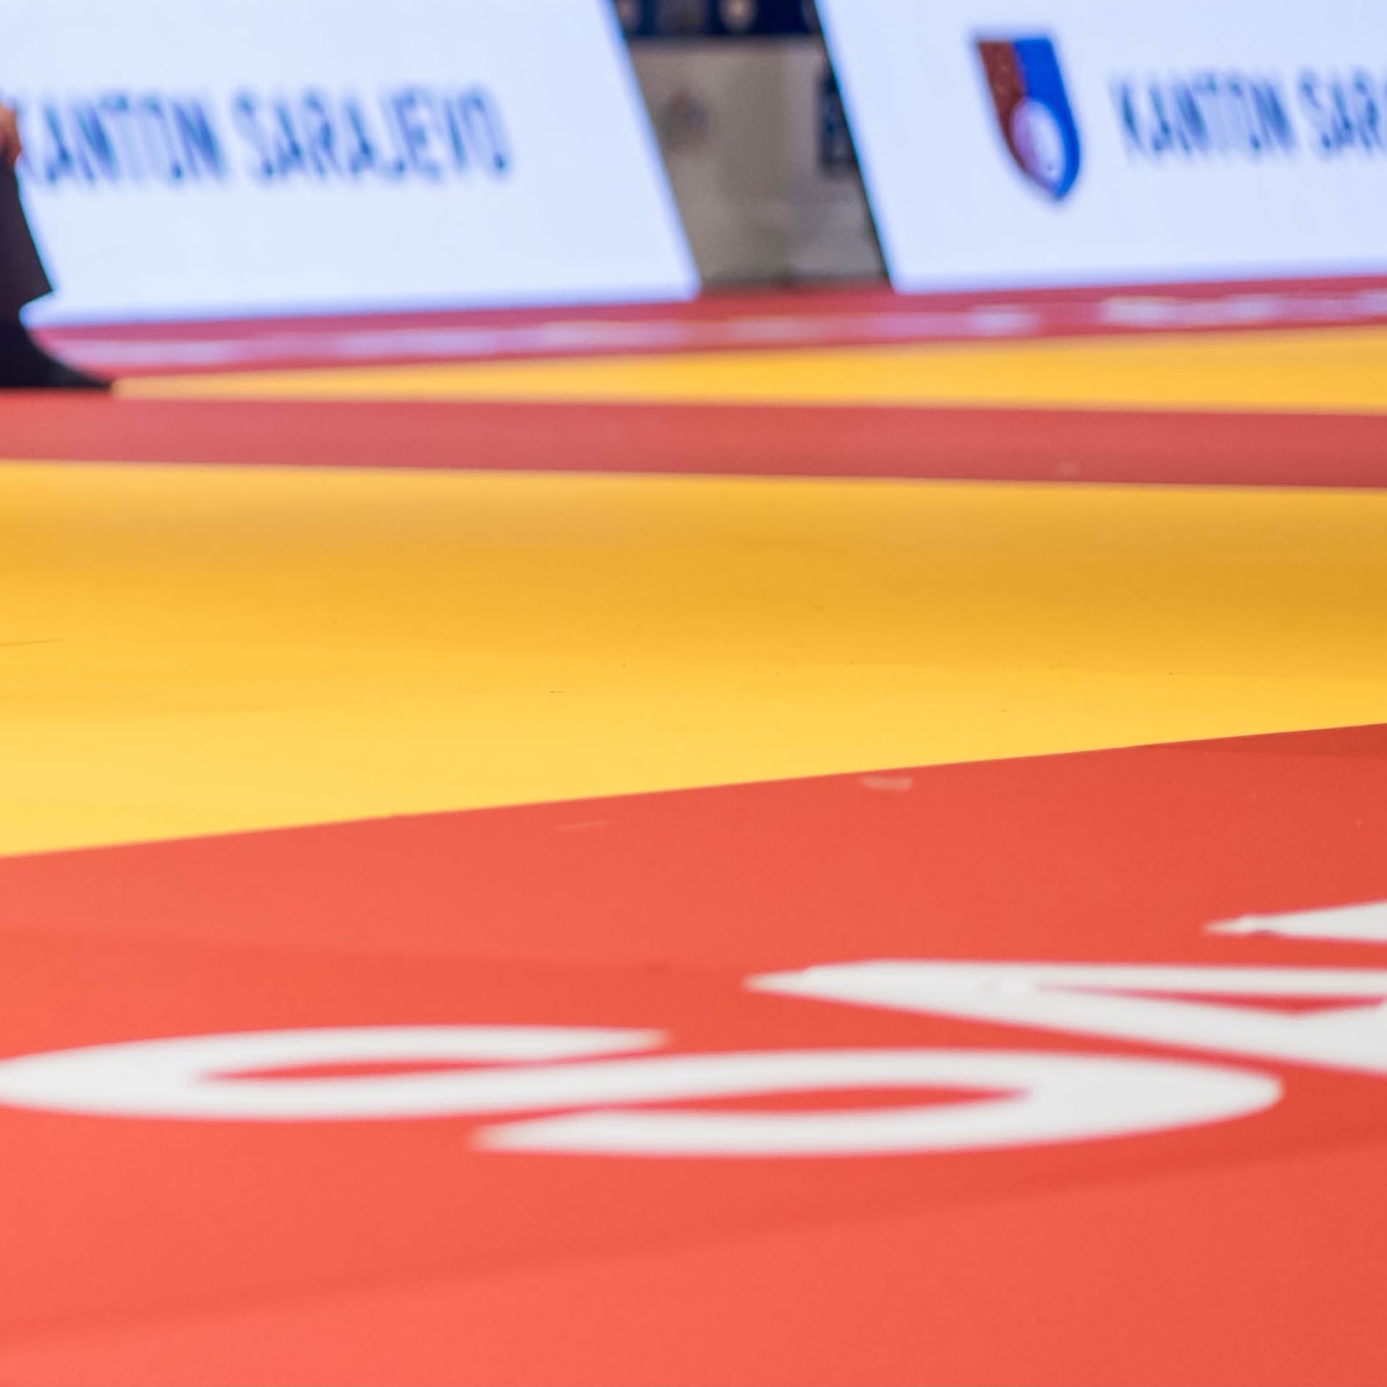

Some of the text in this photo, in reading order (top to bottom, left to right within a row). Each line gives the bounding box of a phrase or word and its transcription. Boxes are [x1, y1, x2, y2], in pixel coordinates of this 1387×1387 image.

[23, 88, 513, 185] ANTON SARAJEVO
[1110, 66, 1387, 160] KANTON SAR
